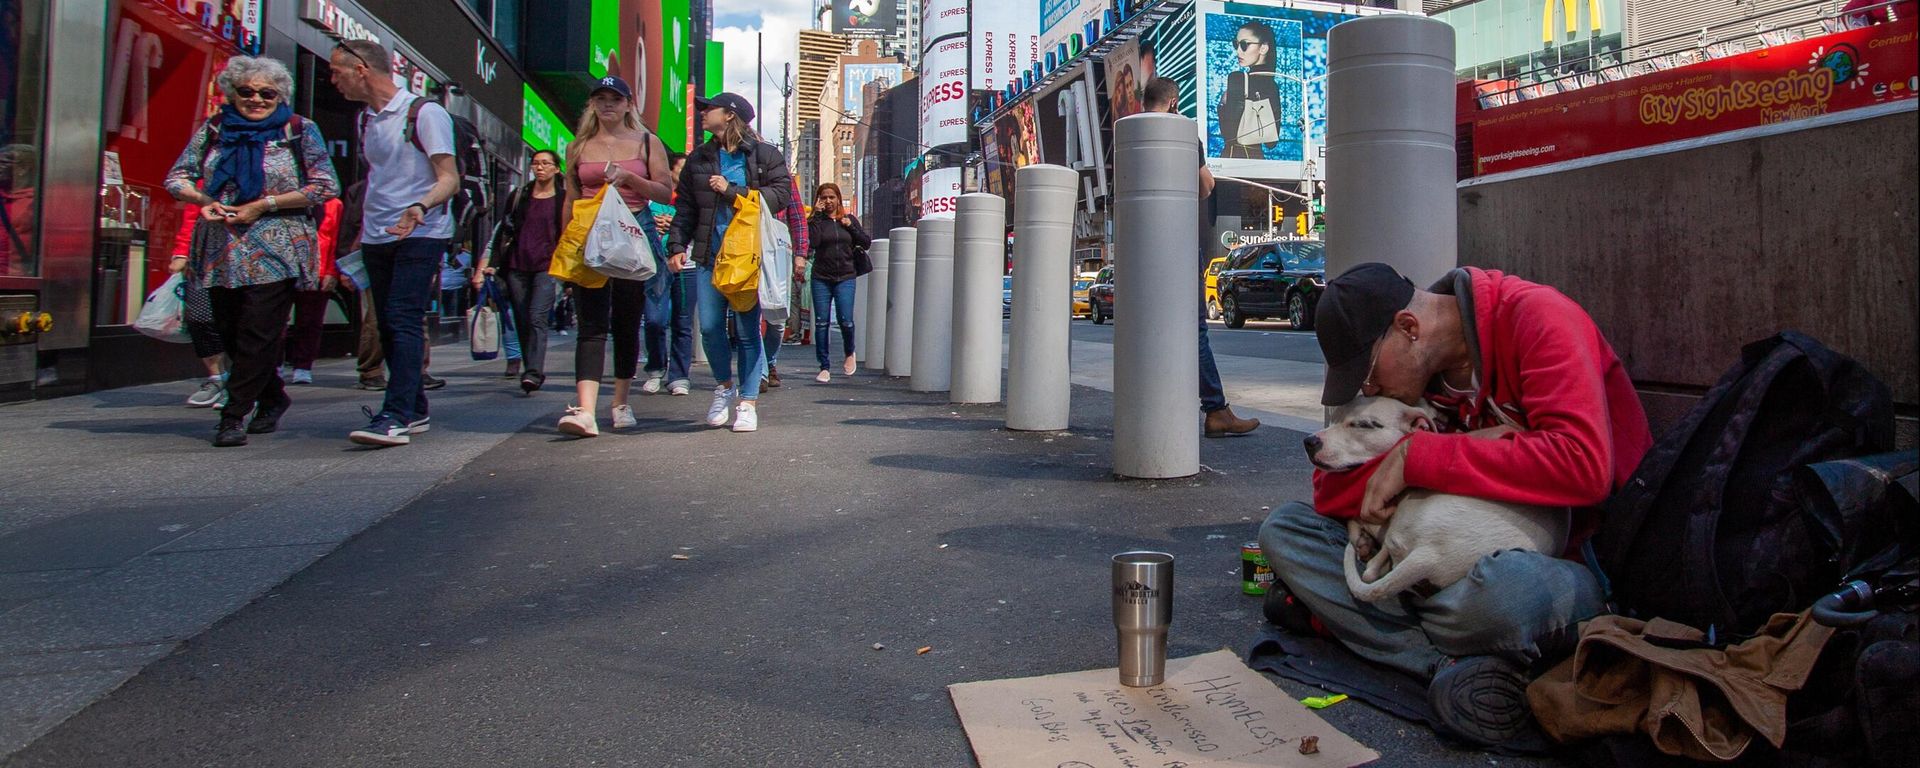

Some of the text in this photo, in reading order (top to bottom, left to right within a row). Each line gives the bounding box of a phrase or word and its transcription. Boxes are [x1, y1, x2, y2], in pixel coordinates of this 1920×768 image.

[940, 7, 967, 18] EXPRES
[1869, 33, 1913, 49] Central
[985, 31, 993, 74] EXPRESS
[1008, 33, 1016, 75] EXPRESS
[849, 68, 867, 81] MY
[1554, 100, 1580, 112] Sqare
[1589, 93, 1616, 104] Empire
[1617, 88, 1638, 98] State
[1640, 81, 1673, 94] Building
[1680, 74, 1712, 87] Harlem
[1480, 144, 1556, 163] newyorksightseeing.com
